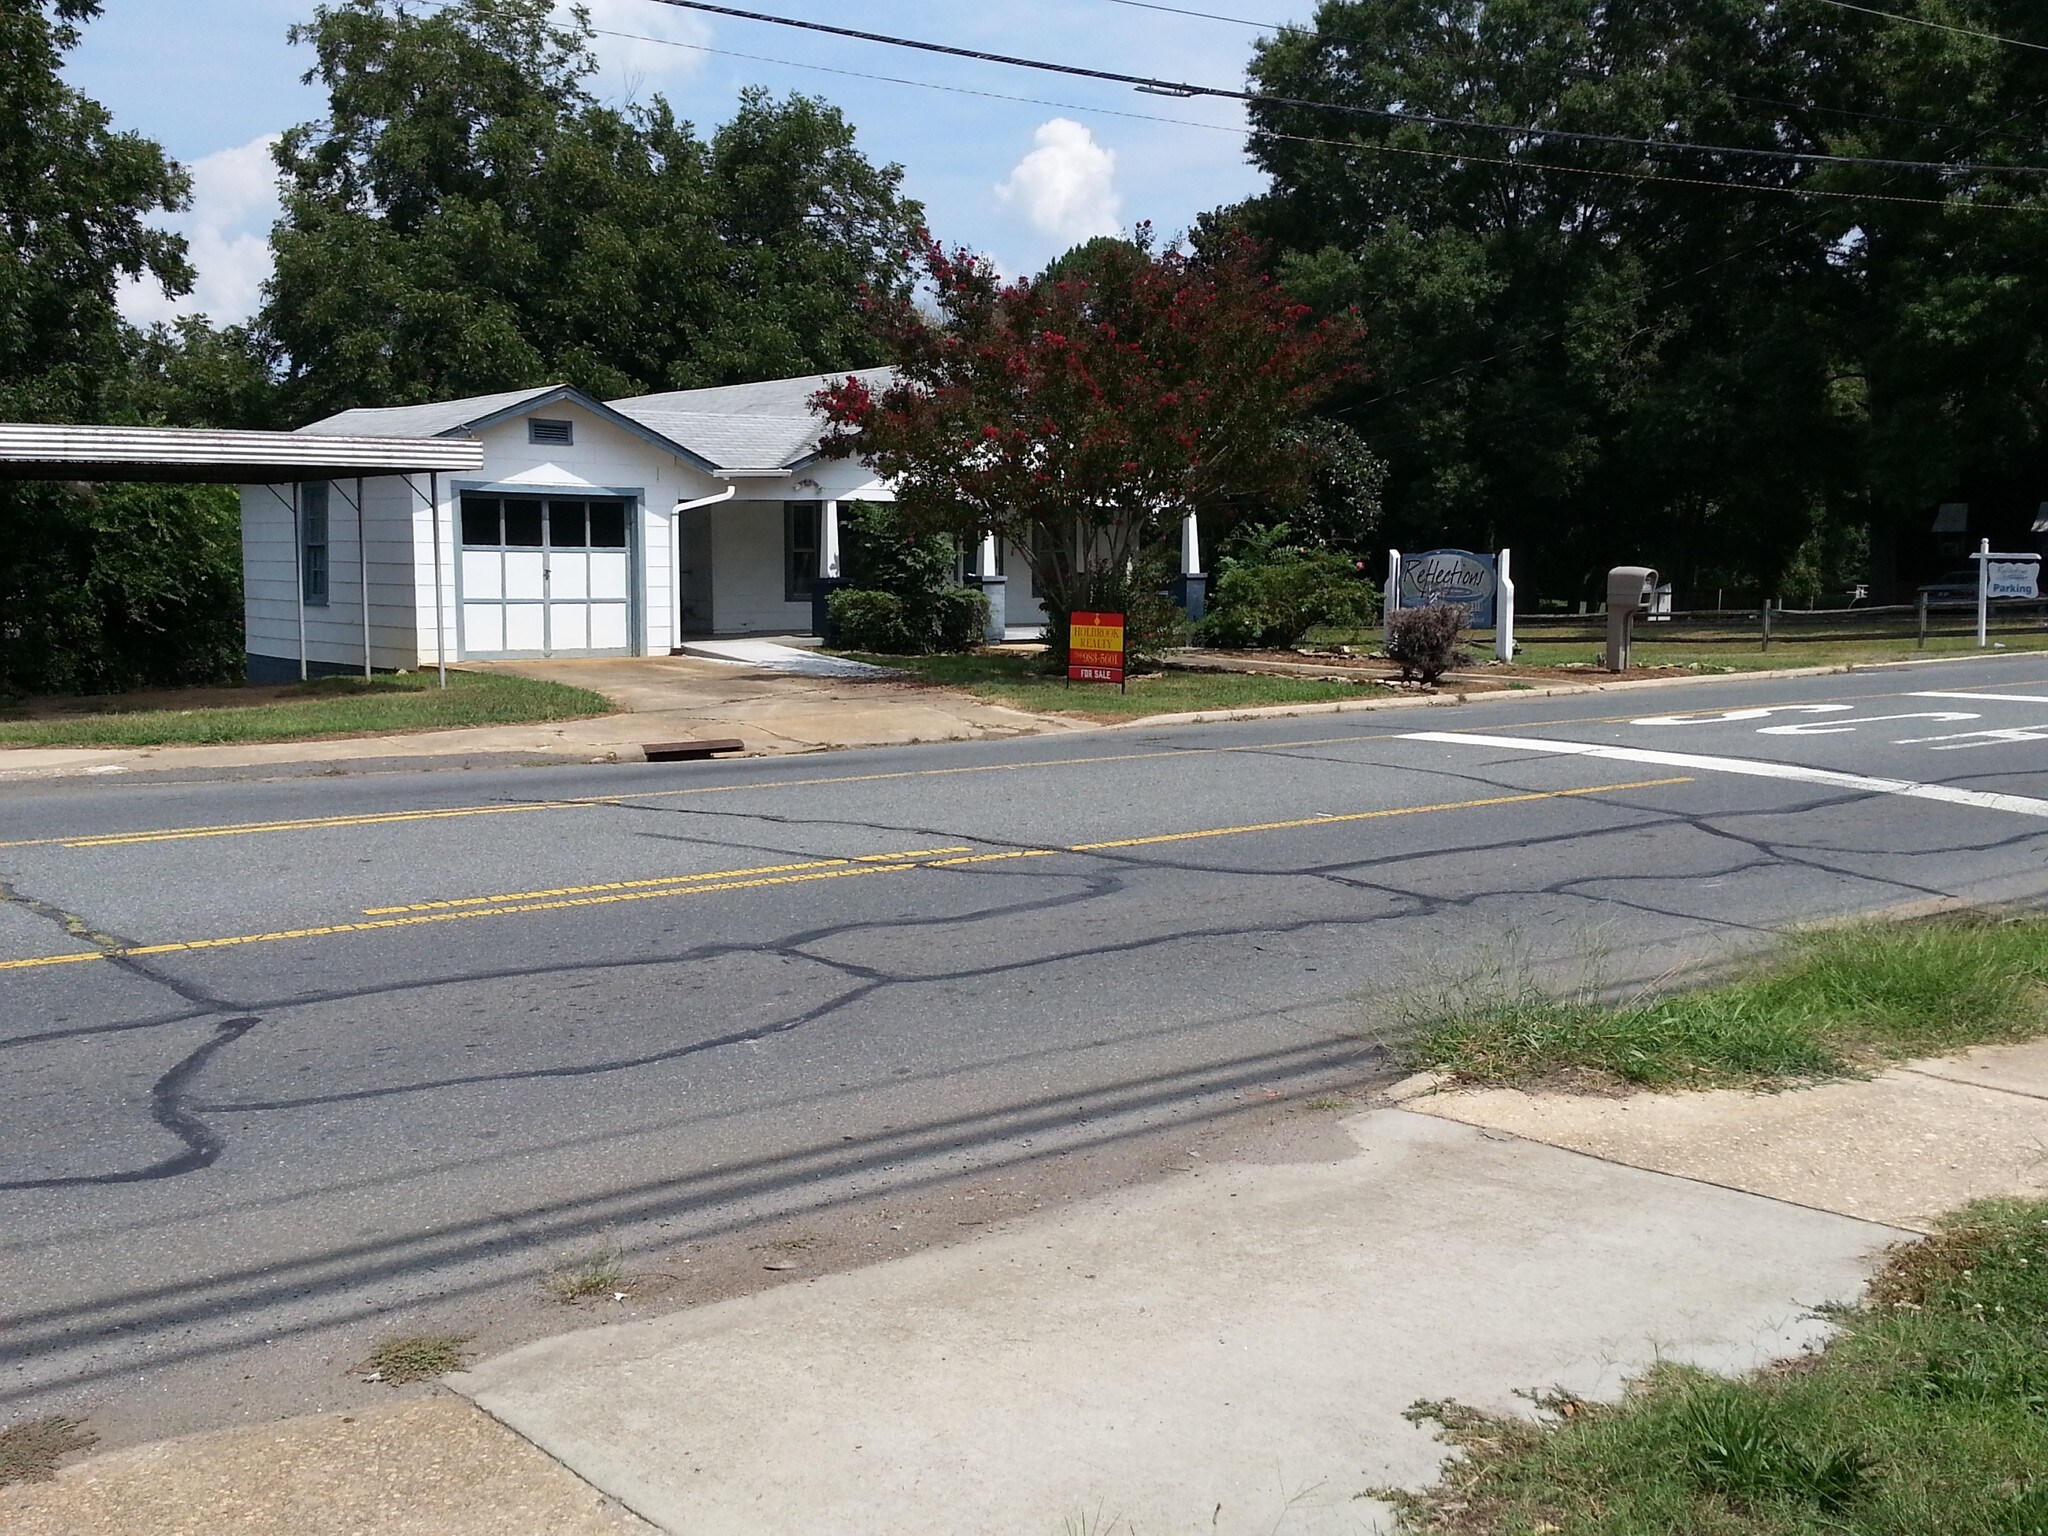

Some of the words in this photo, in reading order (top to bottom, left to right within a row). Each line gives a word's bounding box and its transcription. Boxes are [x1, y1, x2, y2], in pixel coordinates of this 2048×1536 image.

[1403, 559, 1485, 598] Reflections
[1993, 583, 2032, 595] Parking
[1074, 627, 1119, 639] HOLBROOK
[1080, 638, 1112, 649] REALTY
[1080, 669, 1093, 679] FOR
[1094, 670, 1111, 680] SALE
